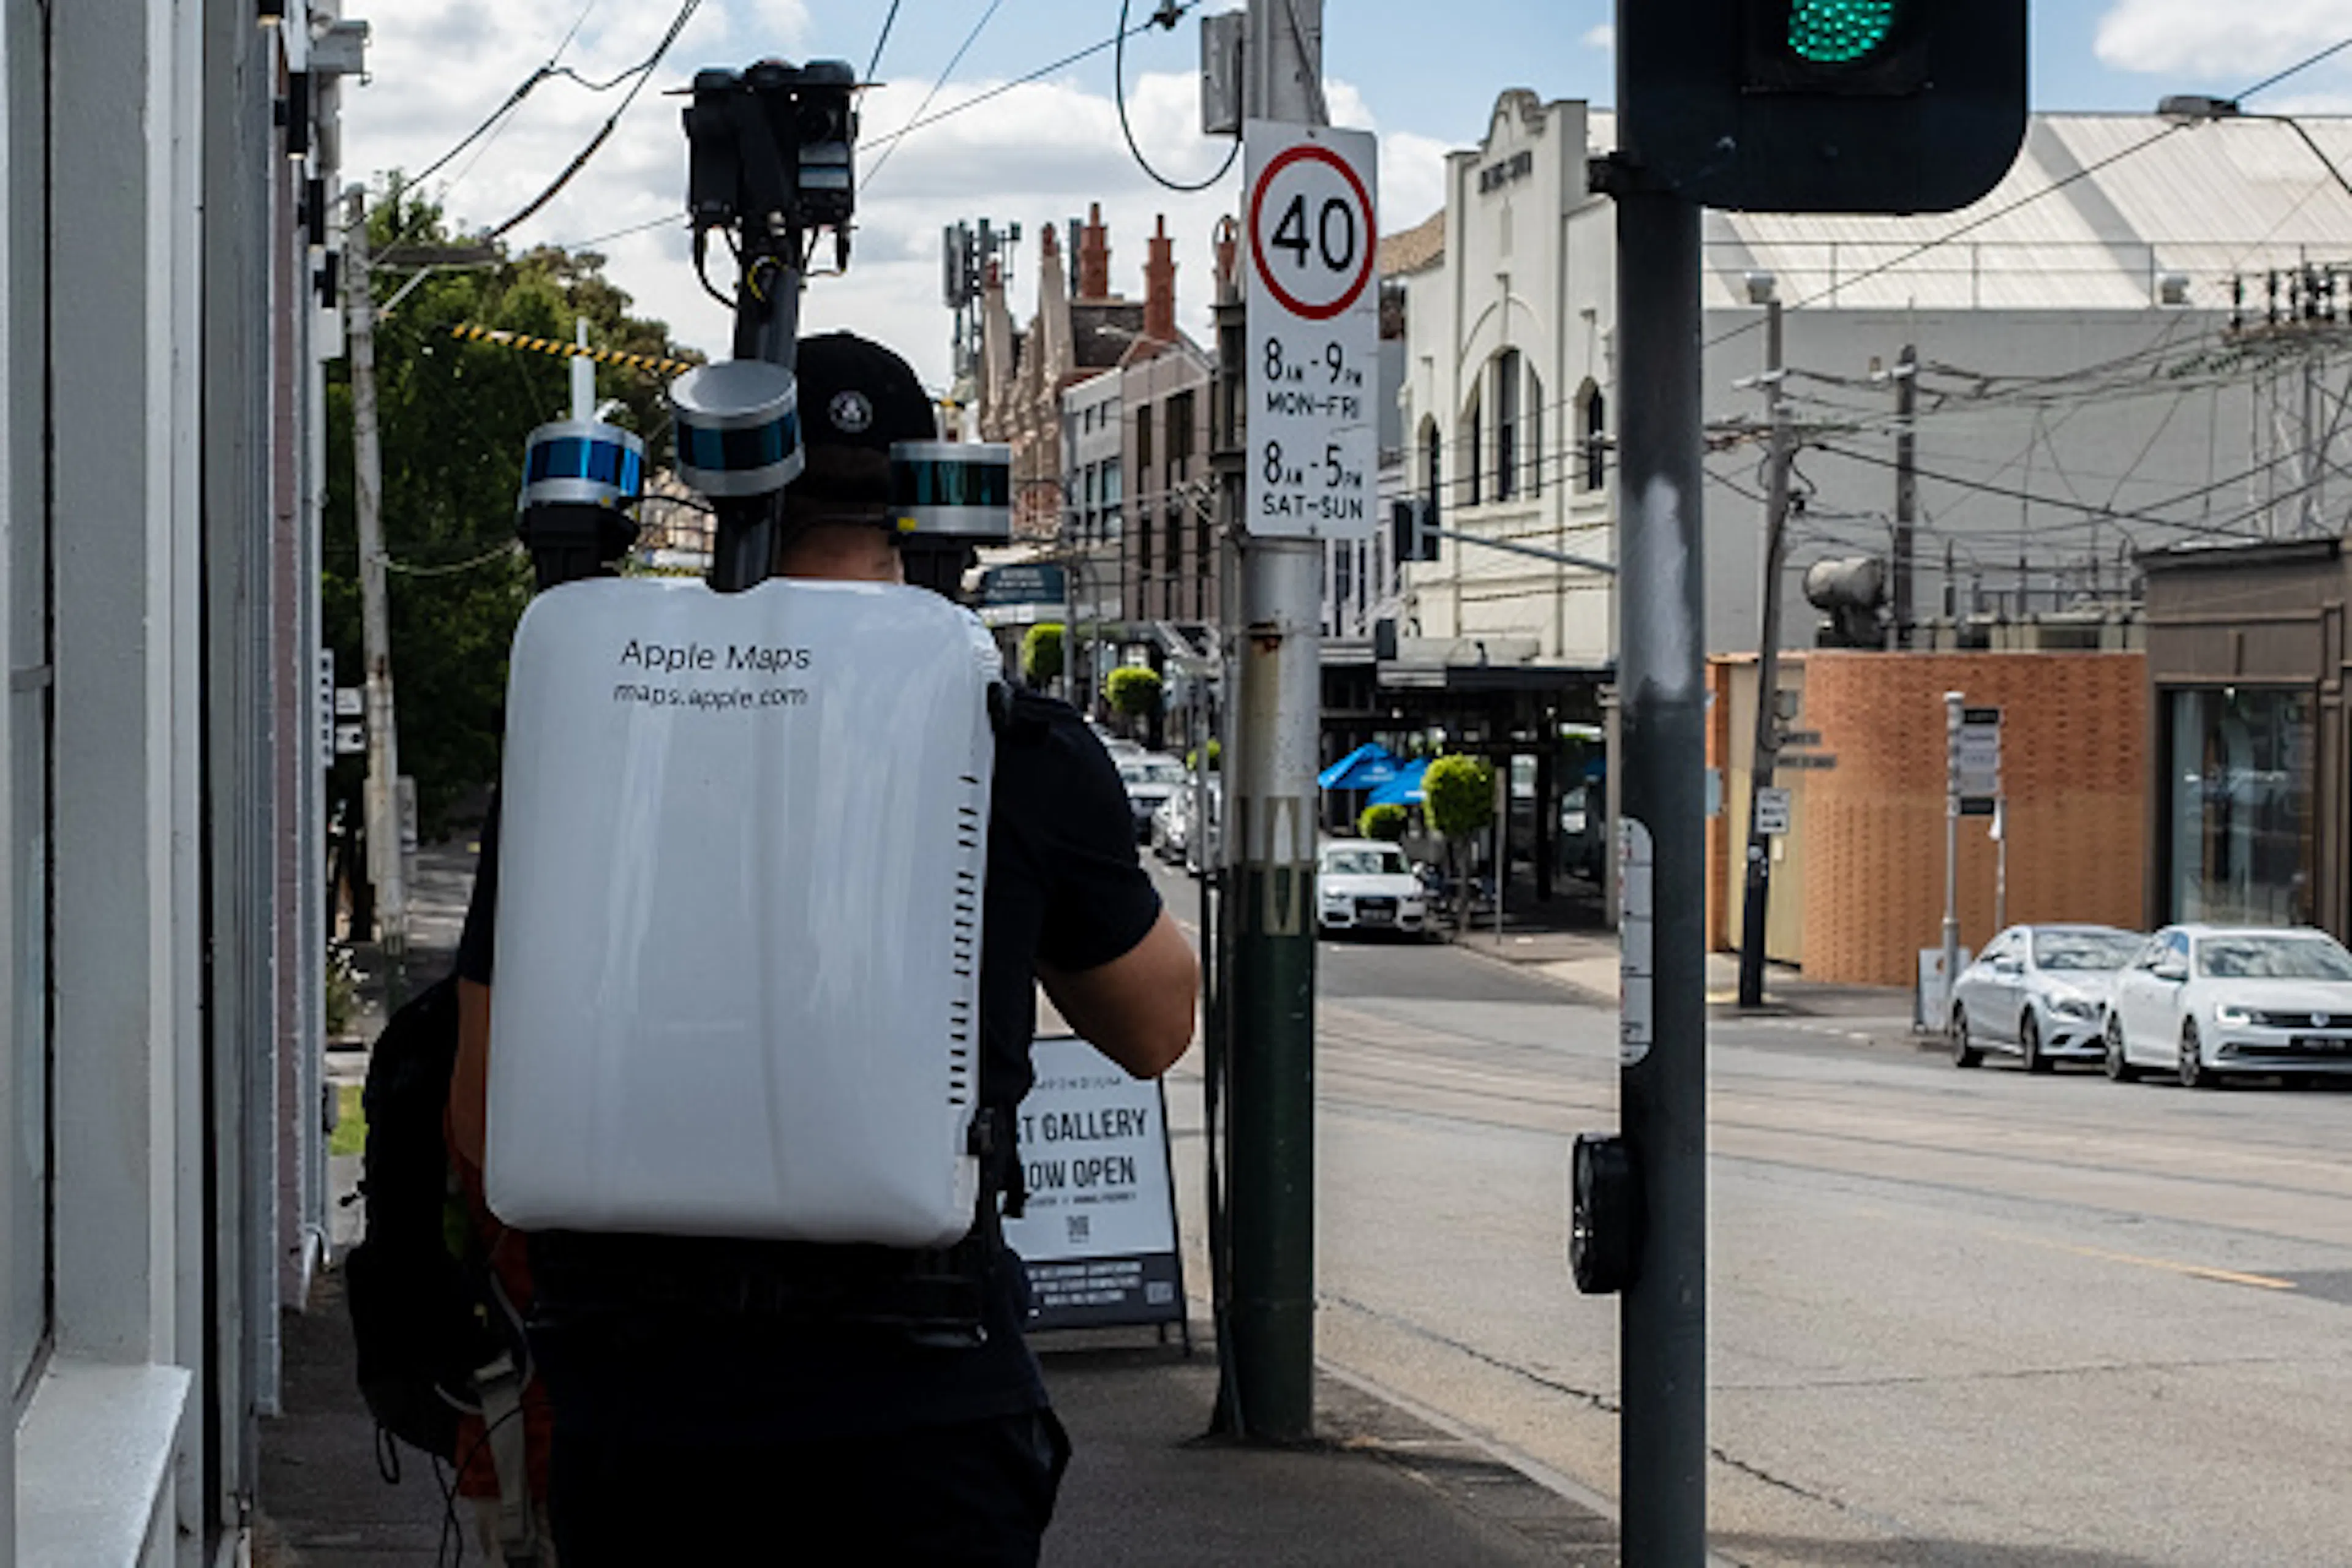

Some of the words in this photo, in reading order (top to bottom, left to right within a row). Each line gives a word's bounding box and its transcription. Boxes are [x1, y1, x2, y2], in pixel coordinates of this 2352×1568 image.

[1270, 193, 1355, 271] 40
[1267, 391, 1359, 420] MON-FRI
[1262, 492, 1363, 519] SAT-SUN
[619, 639, 717, 673] Apple
[725, 644, 812, 674] Maps
[613, 683, 809, 712] maps.apple.com
[1042, 1107, 1147, 1143] GALLERY
[1021, 1159, 1066, 1191] OW
[1073, 1155, 1136, 1188] OPEN
